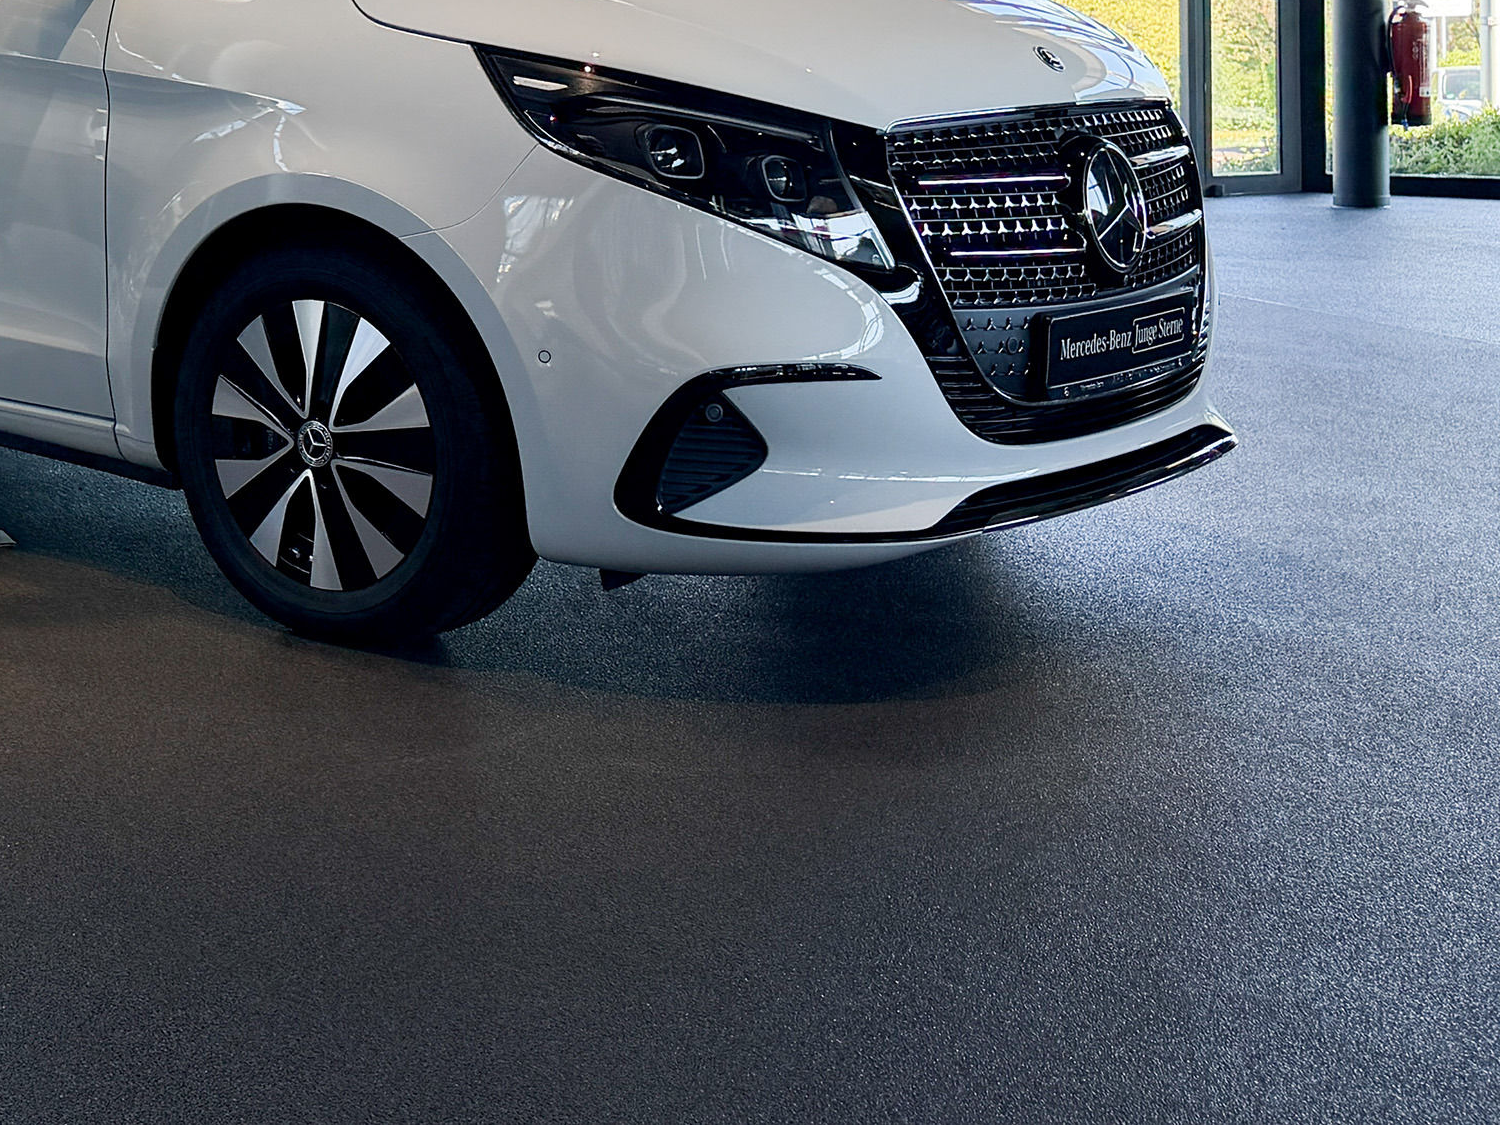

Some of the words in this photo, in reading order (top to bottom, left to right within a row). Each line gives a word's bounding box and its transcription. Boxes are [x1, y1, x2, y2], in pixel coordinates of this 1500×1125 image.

[1060, 329, 1132, 360] Mercedes-Benz
[1134, 324, 1158, 348] Junge
[1158, 317, 1184, 339] Sterne
